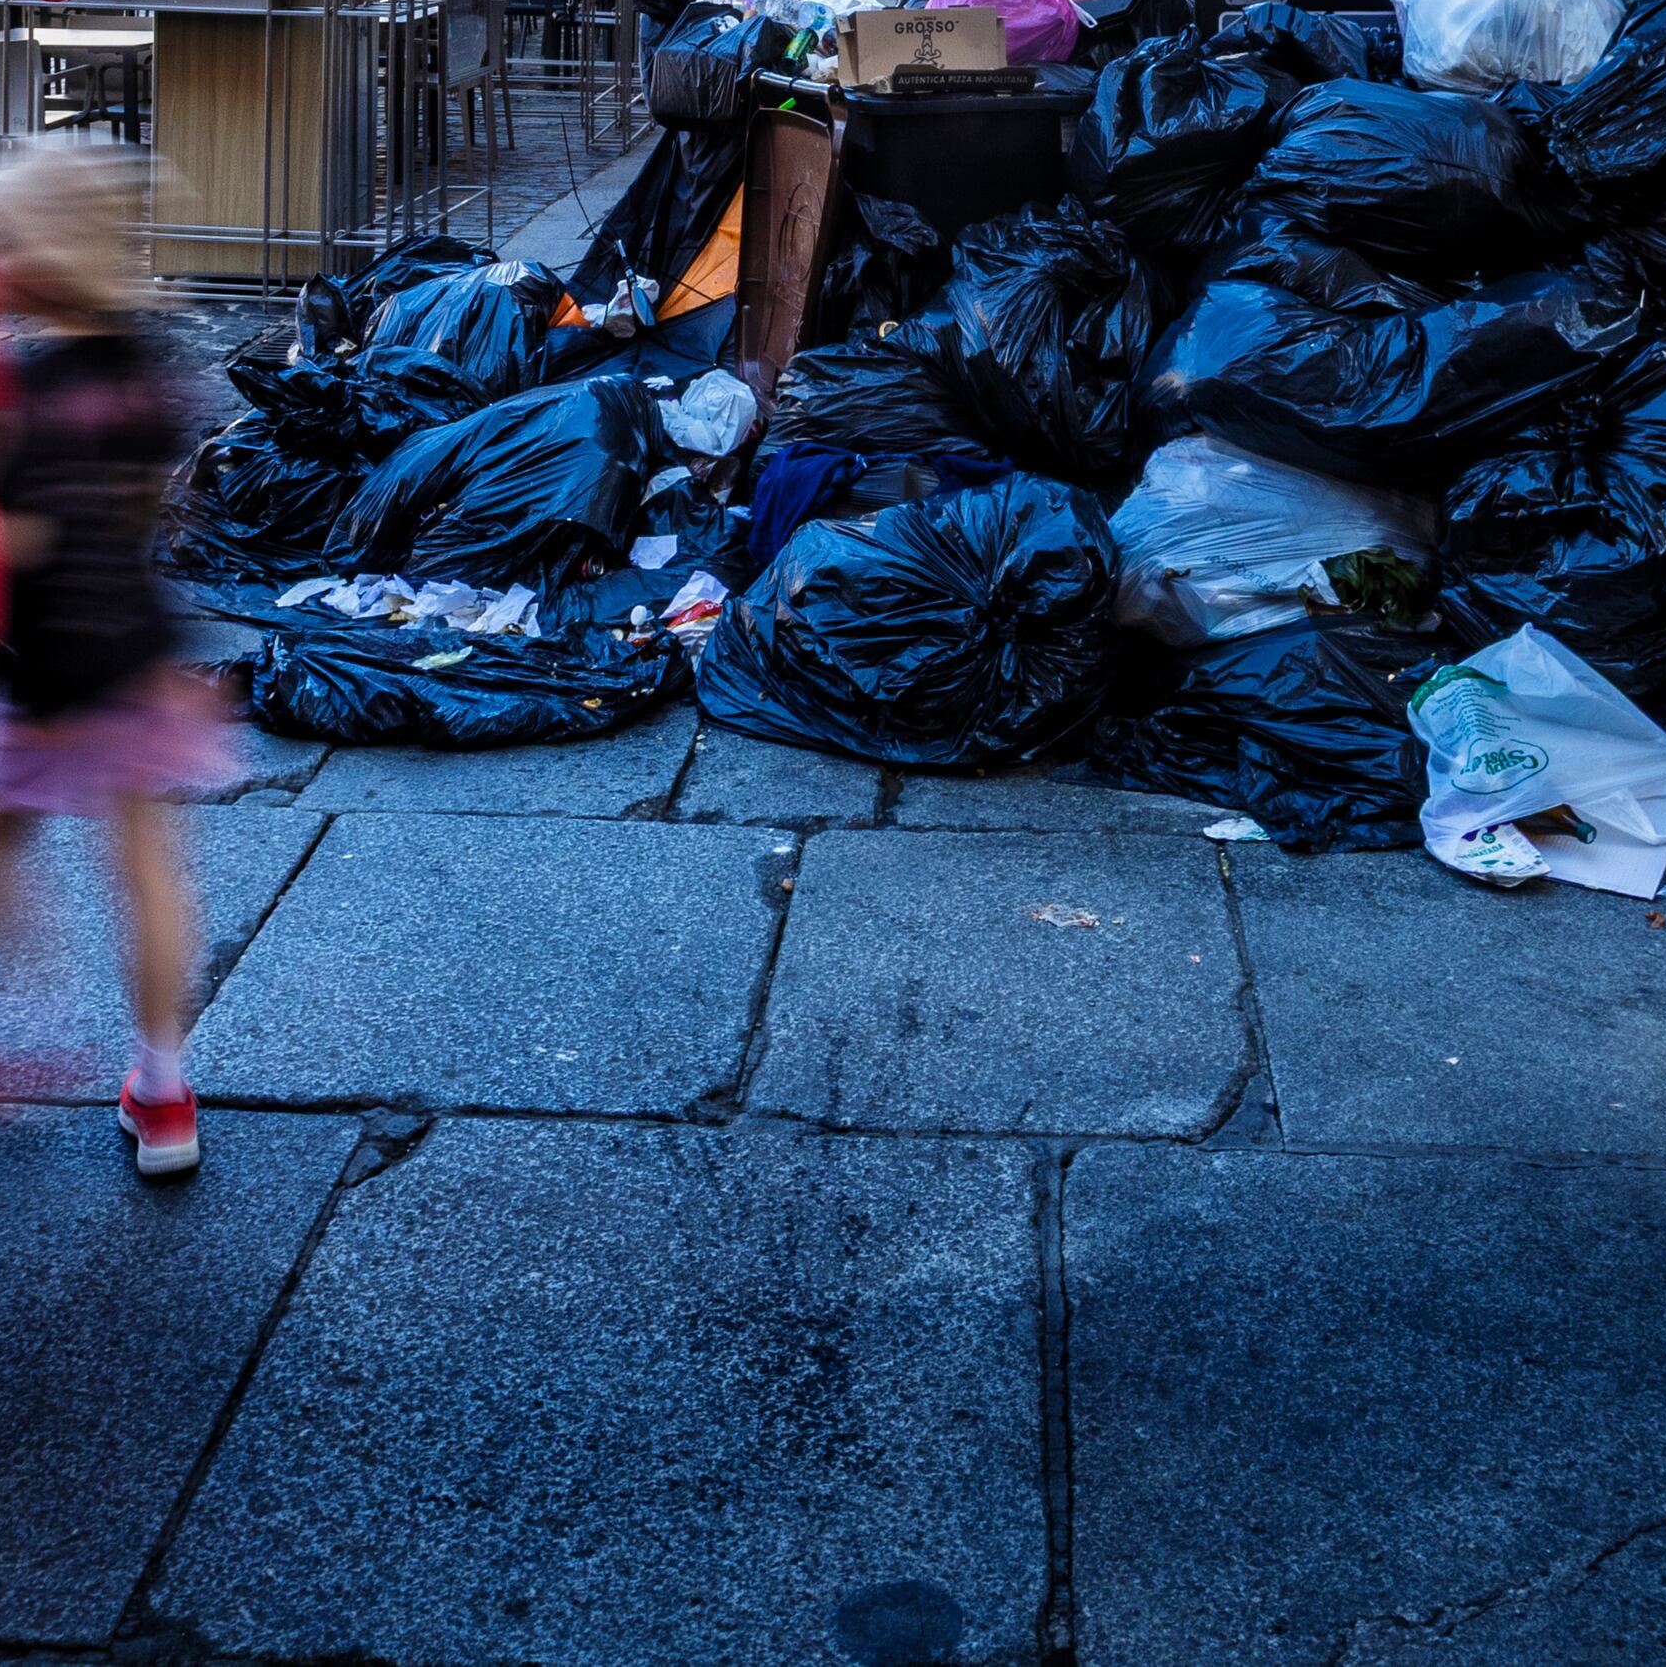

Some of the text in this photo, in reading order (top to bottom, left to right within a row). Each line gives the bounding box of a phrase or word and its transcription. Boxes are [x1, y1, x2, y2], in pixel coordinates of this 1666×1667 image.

[894, 20, 955, 34] GROSSO
[948, 74, 973, 84] PIZZA
[975, 75, 1028, 84] NAPOLITANA
